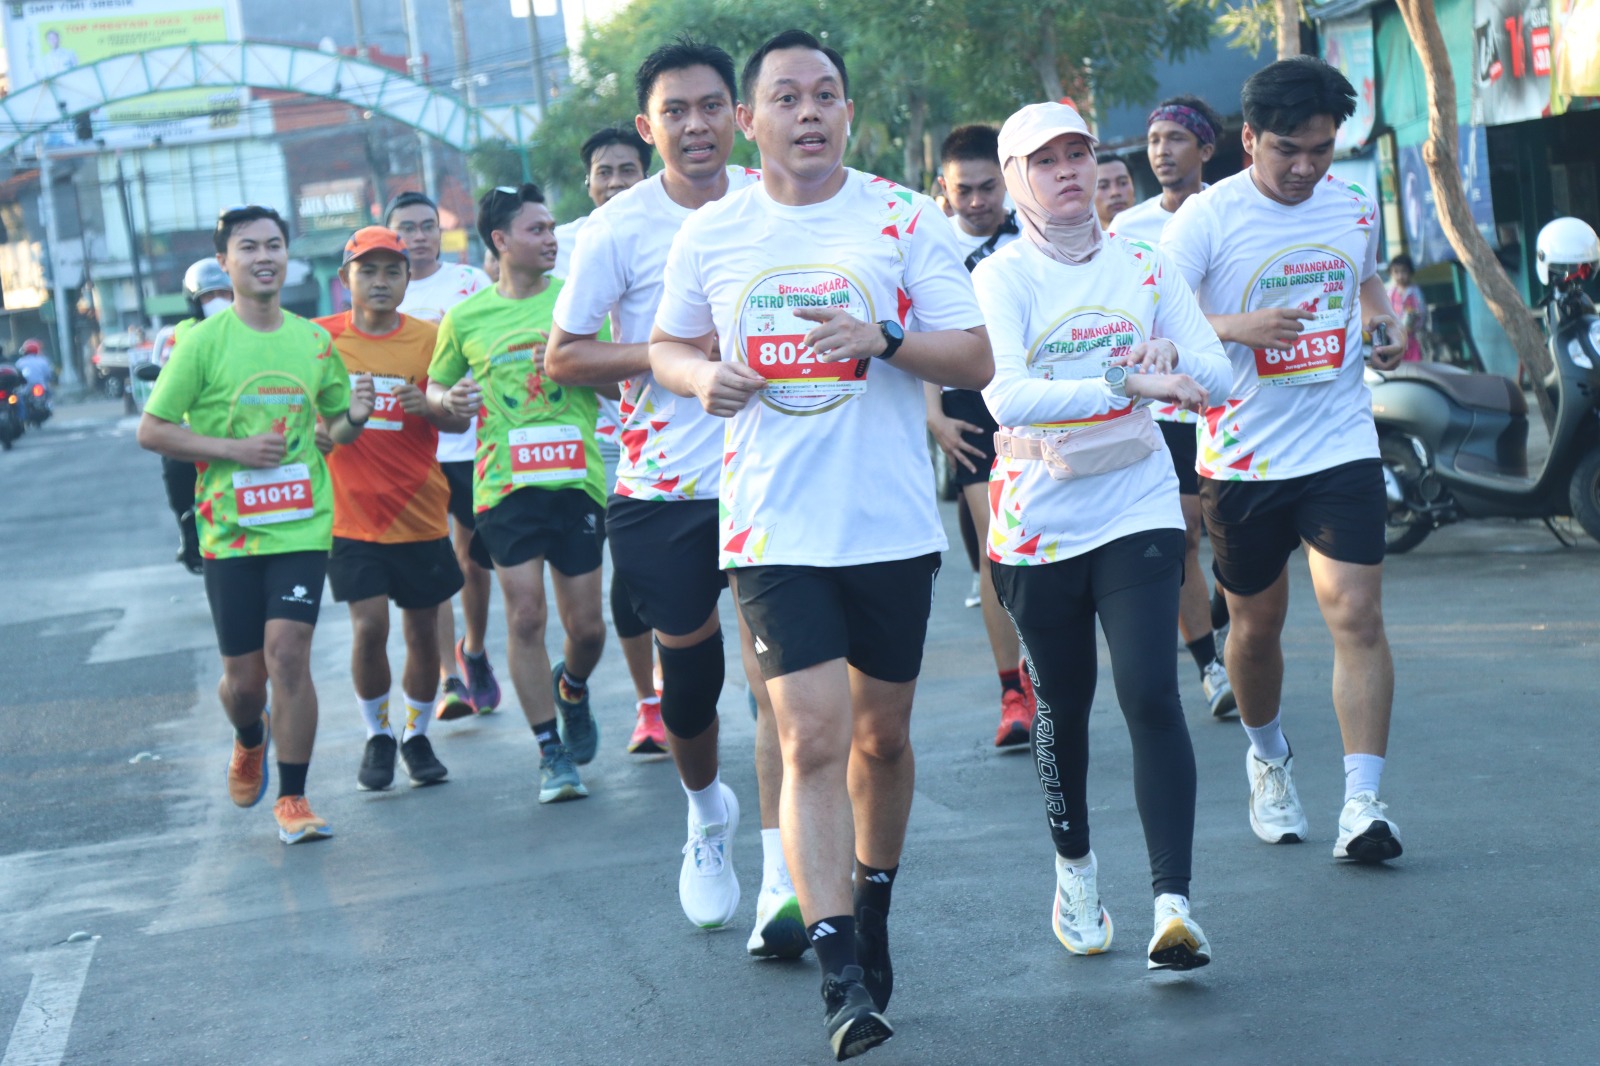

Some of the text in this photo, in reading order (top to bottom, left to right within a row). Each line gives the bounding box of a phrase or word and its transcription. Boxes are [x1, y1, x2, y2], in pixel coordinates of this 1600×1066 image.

[1283, 259, 1345, 276] BHAYANGKARA
[779, 277, 849, 296] BHAYANGKARA
[1260, 270, 1345, 289] PETRO GRISSEE RUN
[1323, 281, 1343, 293] 2024
[750, 290, 850, 309] PETRO GRISSEE RUN
[1071, 321, 1134, 341] BHAYANGKARA
[1044, 333, 1134, 353] PETRO GRISSEE RUN
[1265, 335, 1340, 365] 80138
[759, 341, 851, 366] 802
[518, 444, 578, 463] 81017
[243, 483, 305, 506] 81012
[1035, 699, 1066, 816] ARMOUR
